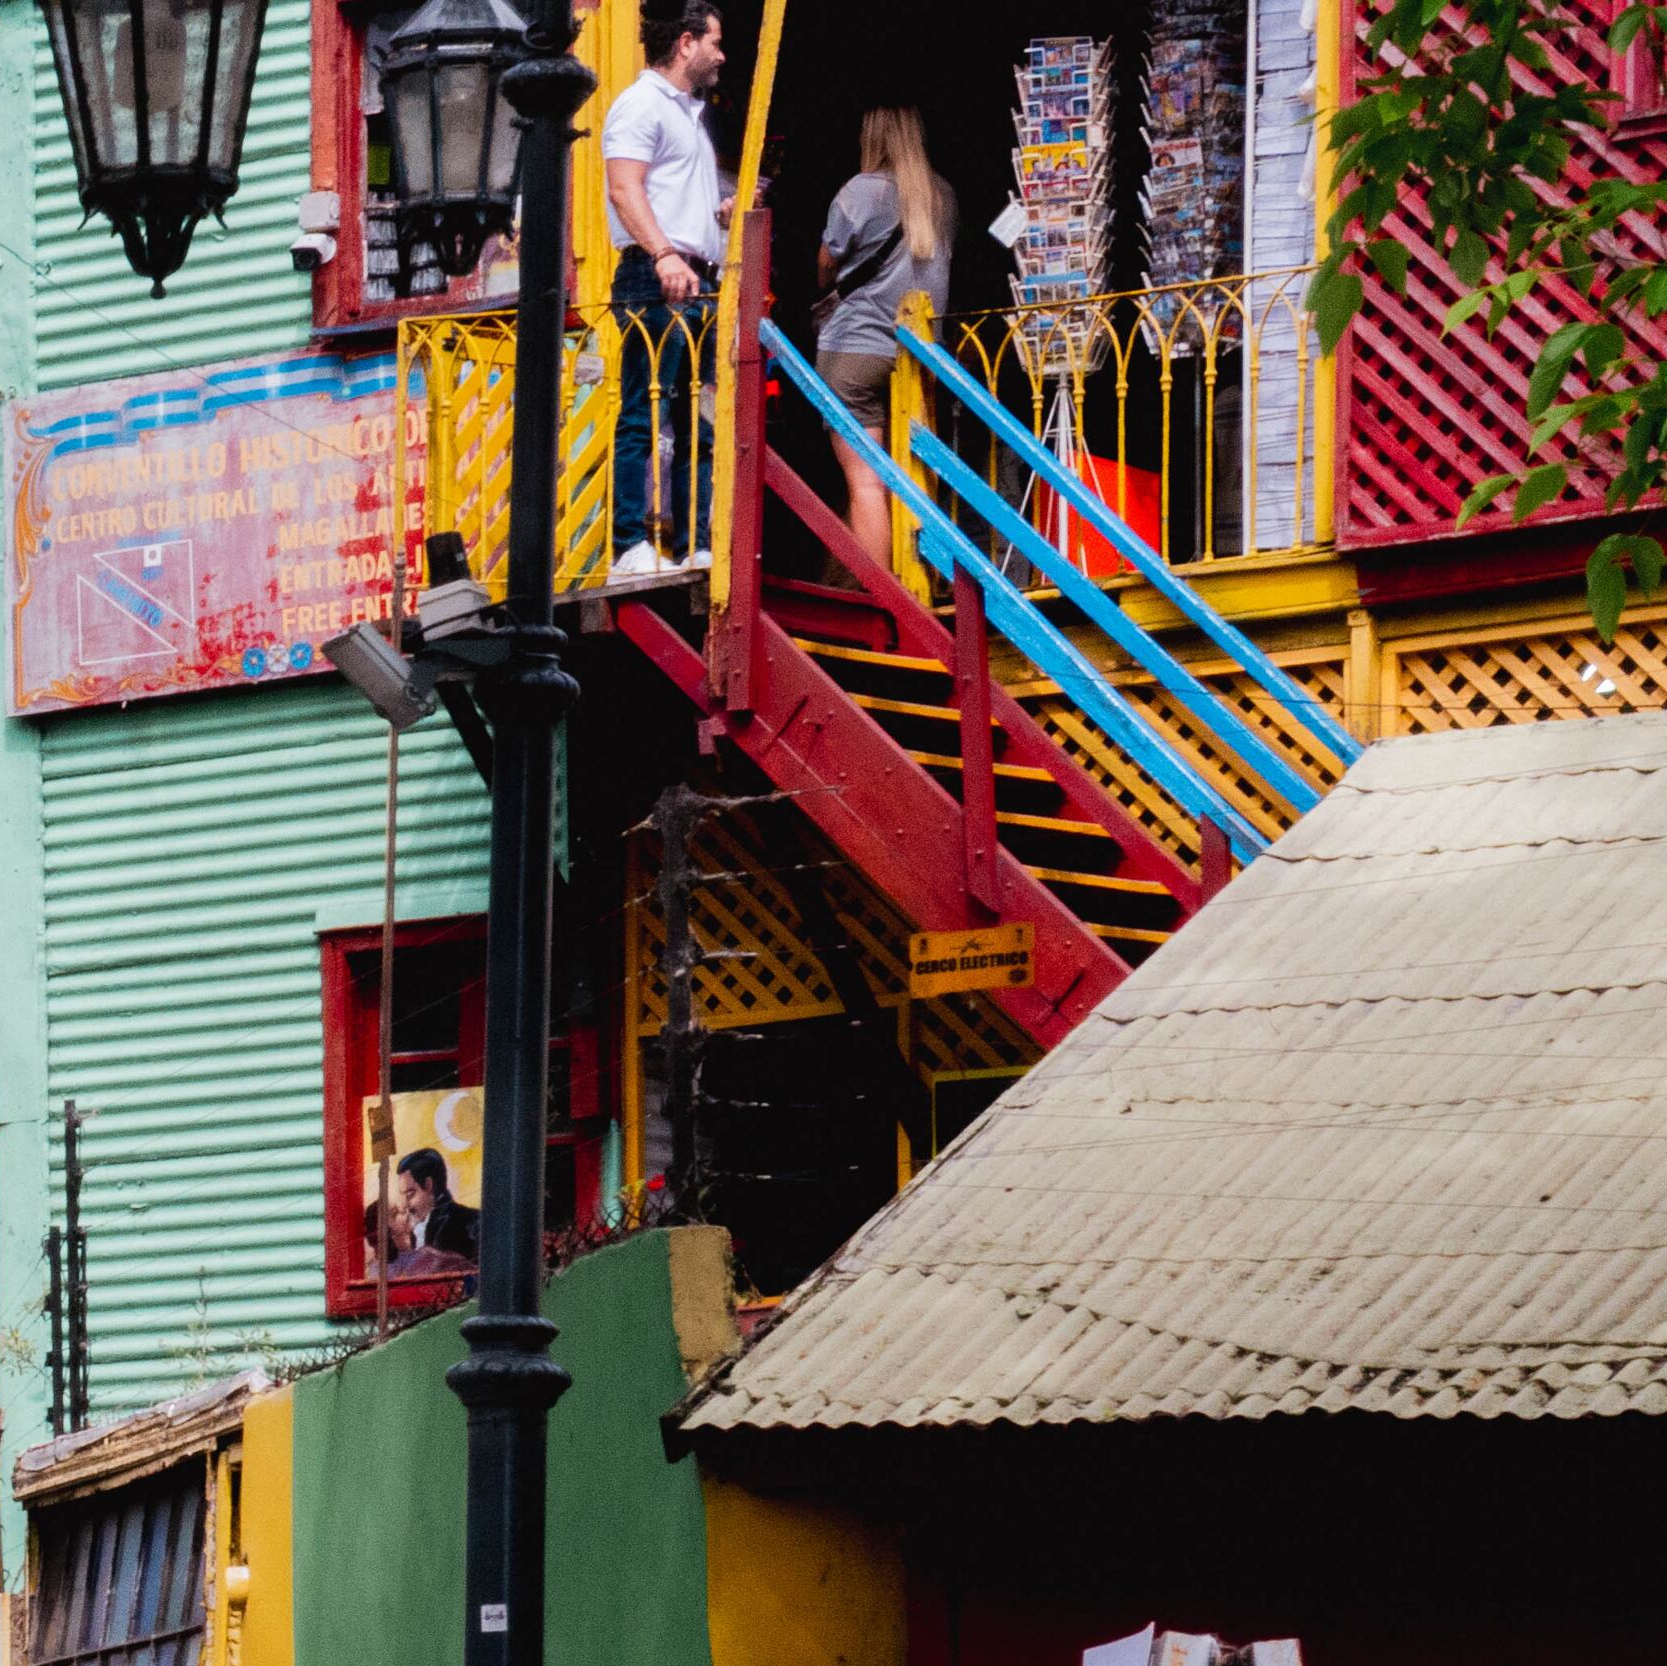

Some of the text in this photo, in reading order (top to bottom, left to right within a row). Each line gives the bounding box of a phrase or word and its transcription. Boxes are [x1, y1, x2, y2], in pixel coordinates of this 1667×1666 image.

[53, 441, 227, 501] CONVENTILLO
[239, 413, 391, 474] HISTORICO
[56, 505, 137, 544] CENTRO
[142, 487, 260, 530] CULTURAL
[315, 472, 358, 505] LOS
[280, 550, 394, 593] ENTRADA
[282, 604, 342, 636] FREE
[916, 959, 957, 975] CERCO
